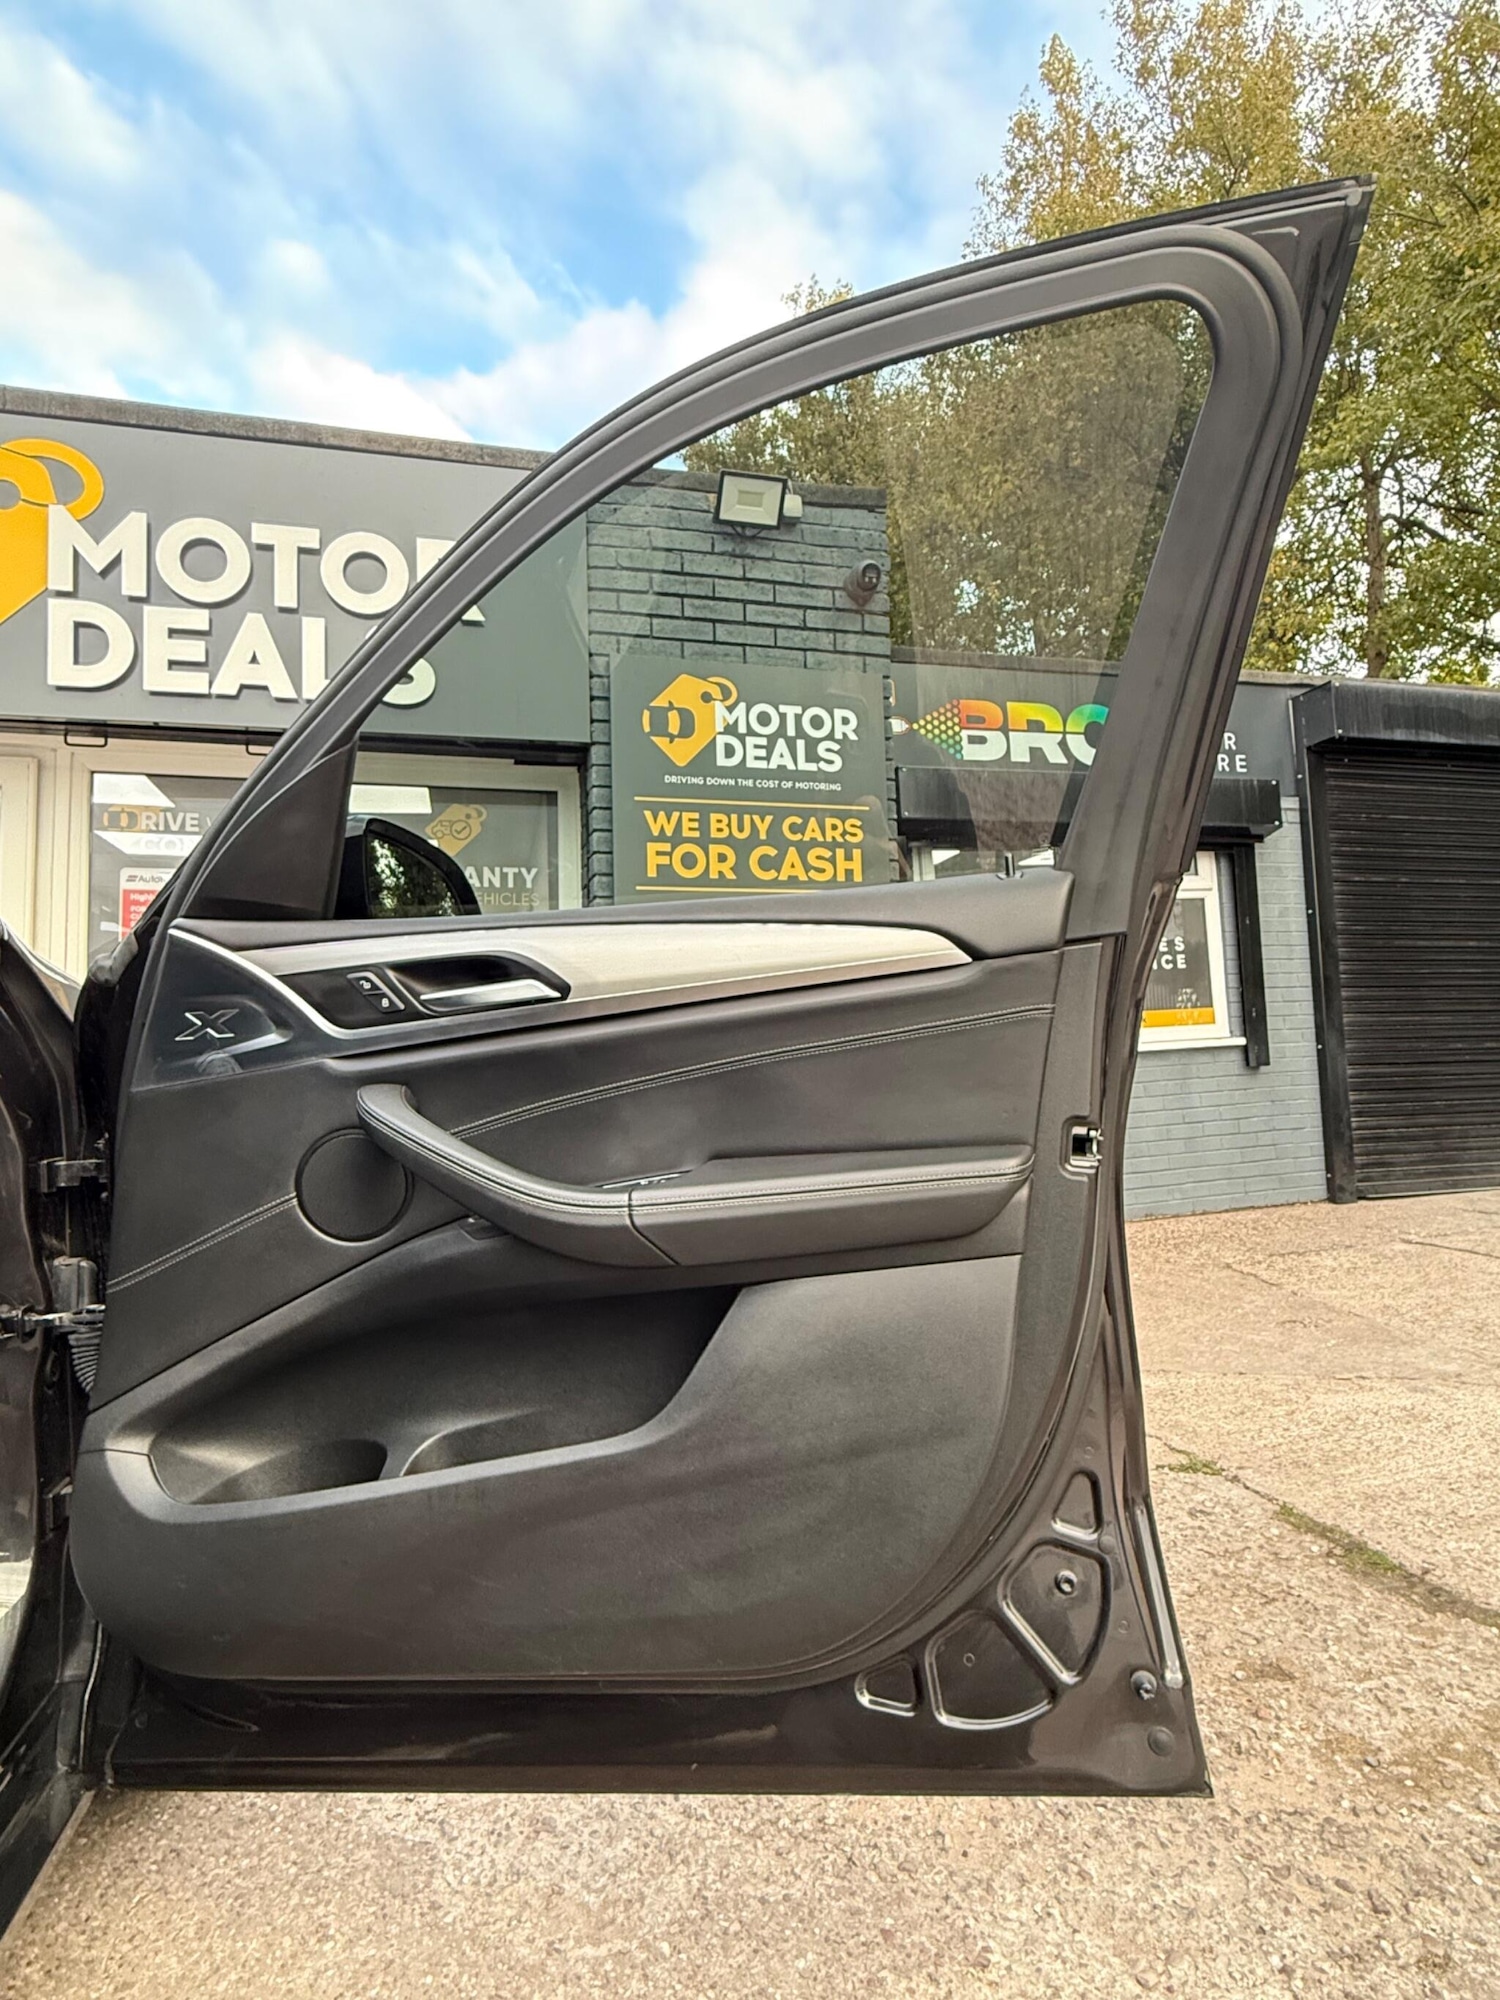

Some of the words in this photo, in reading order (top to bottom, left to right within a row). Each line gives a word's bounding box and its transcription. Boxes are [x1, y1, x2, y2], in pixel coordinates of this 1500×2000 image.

[714, 700, 859, 741] MOTOR
[715, 735, 843, 773] DEALS
[1217, 753, 1248, 773] RE
[664, 775, 704, 785] DRIVING
[706, 777, 736, 787] DOWN
[737, 778, 754, 788] THE
[755, 779, 779, 789] COST
[781, 780, 794, 789] OF
[795, 781, 842, 792] MOTORING
[643, 809, 700, 838] WE
[709, 813, 774, 841] BUY
[782, 815, 864, 844] CARS
[646, 842, 737, 880] FOR
[749, 845, 863, 883] CASH
[464, 865, 539, 889] ANTY
[477, 891, 541, 907] EHICLES
[1152, 953, 1187, 970] ICE
